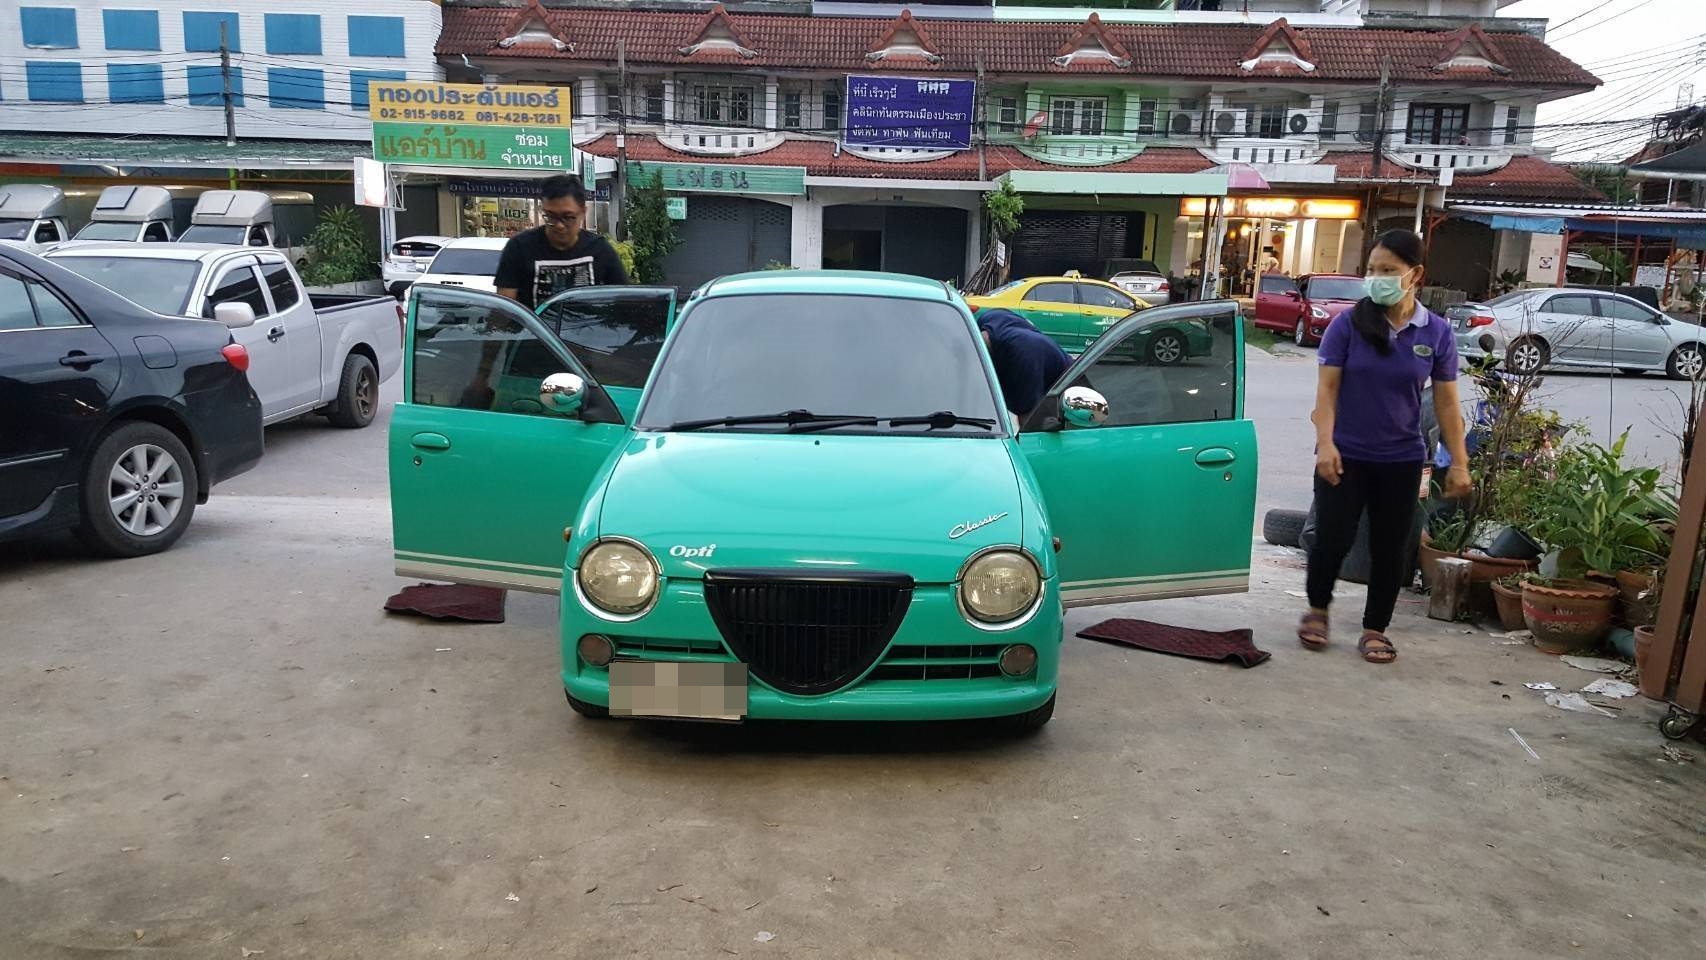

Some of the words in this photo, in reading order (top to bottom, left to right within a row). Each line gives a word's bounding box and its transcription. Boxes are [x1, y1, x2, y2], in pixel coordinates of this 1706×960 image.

[377, 85, 559, 108] ทองประดับแอร์
[380, 107, 465, 121] 02-915-9682
[475, 111, 561, 124] 081-428-1281
[380, 126, 486, 160] แอร์บ้าน
[515, 128, 549, 147] ซ่อม
[501, 147, 563, 166] จำหน่าย
[948, 511, 1008, 539] Classic
[669, 543, 717, 558] Opti
